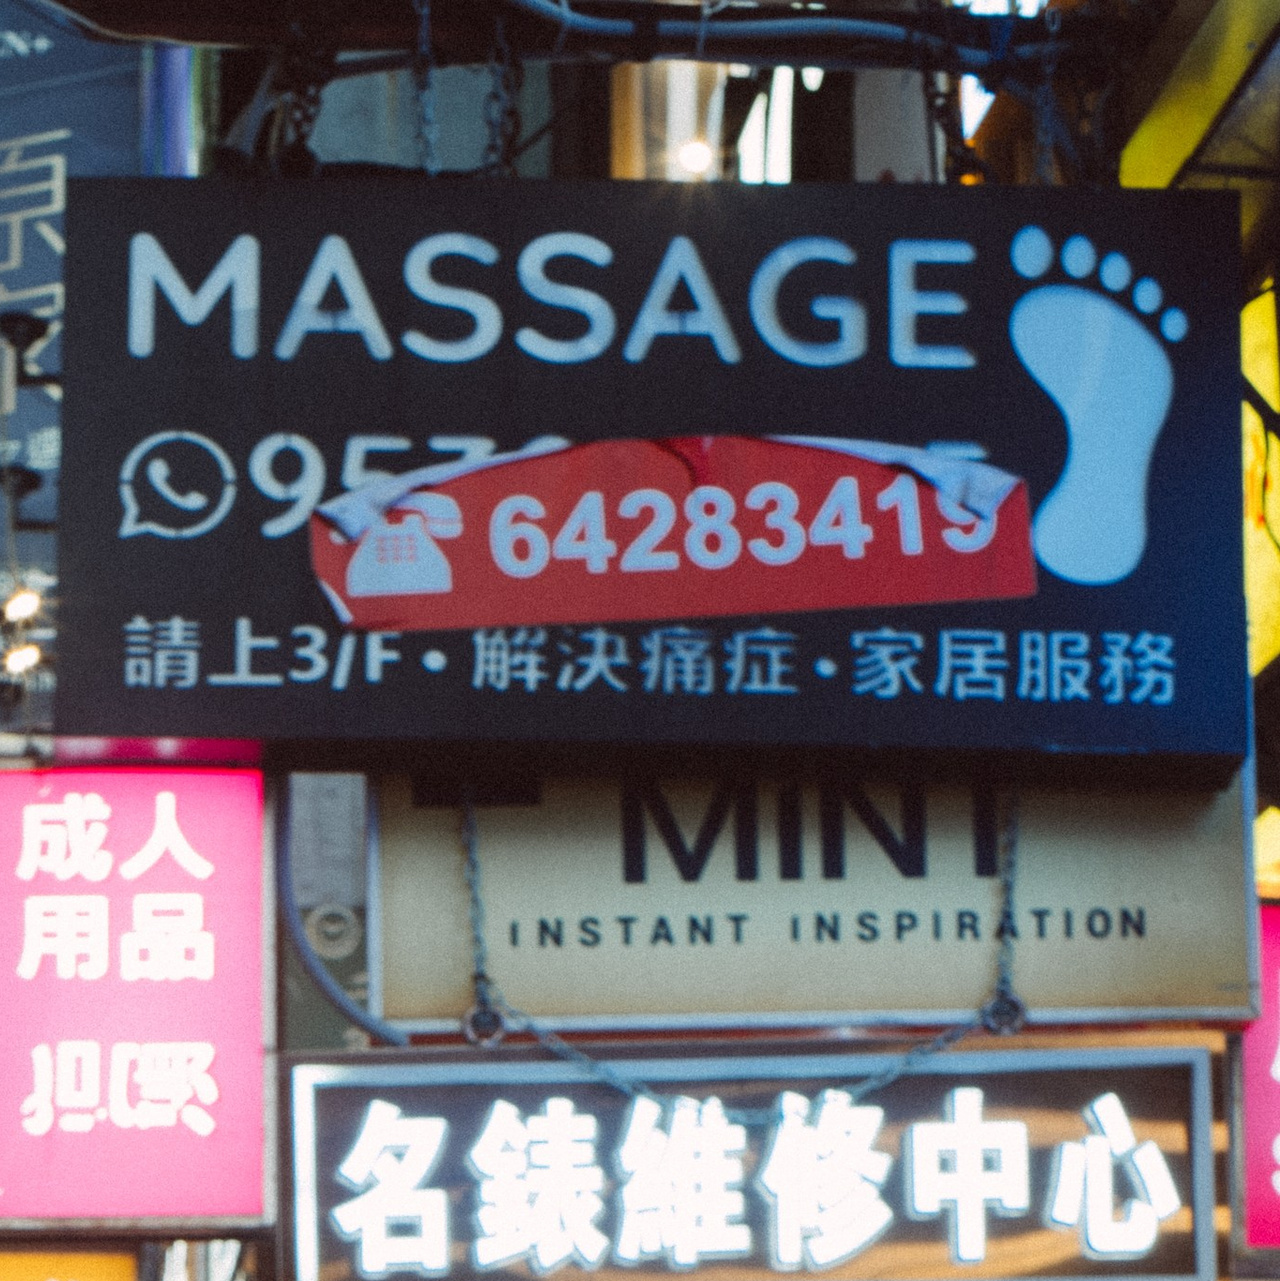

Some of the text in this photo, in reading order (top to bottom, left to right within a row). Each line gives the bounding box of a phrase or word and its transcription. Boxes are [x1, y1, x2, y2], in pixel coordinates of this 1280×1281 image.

[127, 232, 977, 368] MASSAGE
[16, 792, 215, 882] 成人
[16, 893, 216, 981] 用品
[509, 906, 1149, 948] INSTANT INSPIRATION
[332, 1086, 1180, 1280] 名錶維修中心
